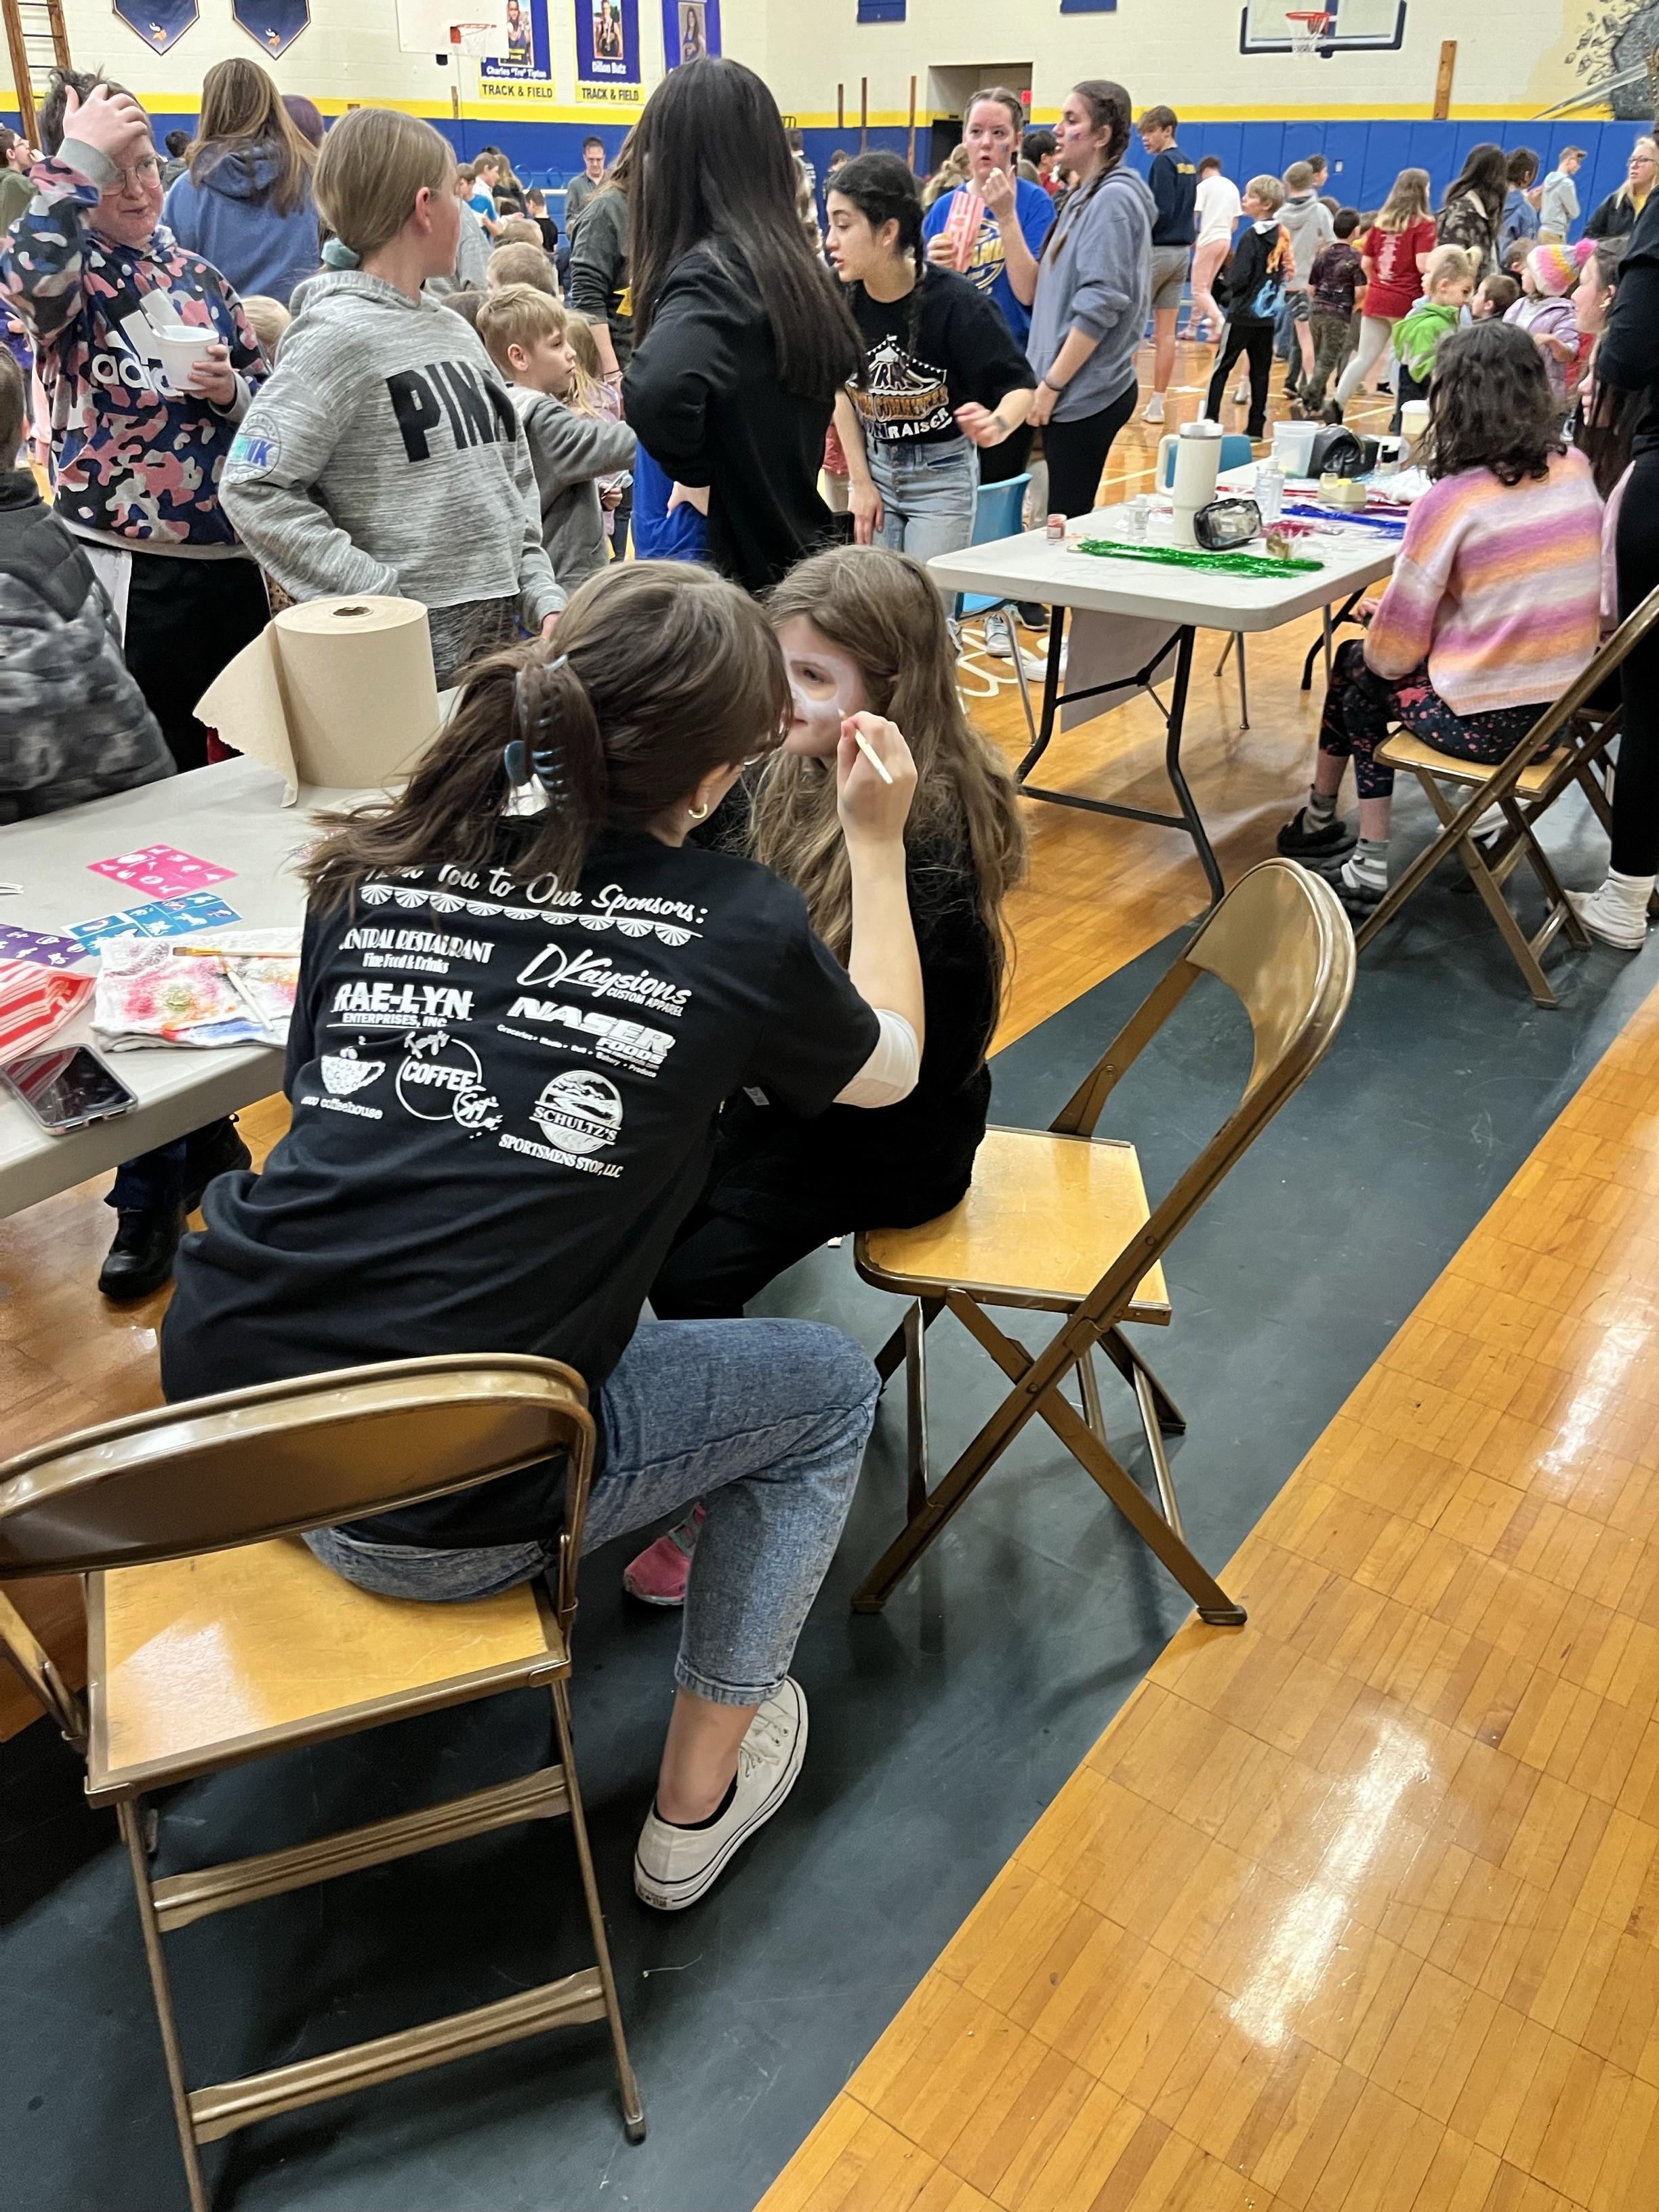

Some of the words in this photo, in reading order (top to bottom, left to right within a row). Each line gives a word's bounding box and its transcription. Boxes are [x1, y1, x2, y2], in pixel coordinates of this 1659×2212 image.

[482, 84, 515, 96] TRACK
[518, 86, 525, 96] &
[527, 87, 553, 98] FIELD
[581, 87, 609, 100] TRACK
[610, 89, 617, 100] &
[618, 89, 640, 101] FIELD
[385, 361, 516, 463] PINK
[489, 867, 516, 897] to
[526, 872, 583, 907] Our
[591, 883, 709, 924] Sponsors:
[395, 930, 495, 964] RESTAURANT
[414, 956, 450, 974] Drinks
[331, 981, 474, 1021] RAE-LYN
[607, 988, 646, 1004] CUSTOM
[644, 996, 684, 1017] APPAREL
[342, 1012, 420, 1027] ENTERPRISES,
[506, 996, 676, 1057] NASER
[596, 1037, 665, 1065] FOODS
[402, 1061, 487, 1092] COFFEE
[533, 1106, 618, 1141] SCHULTZ'S
[498, 1133, 577, 1167] SPORTSMENS
